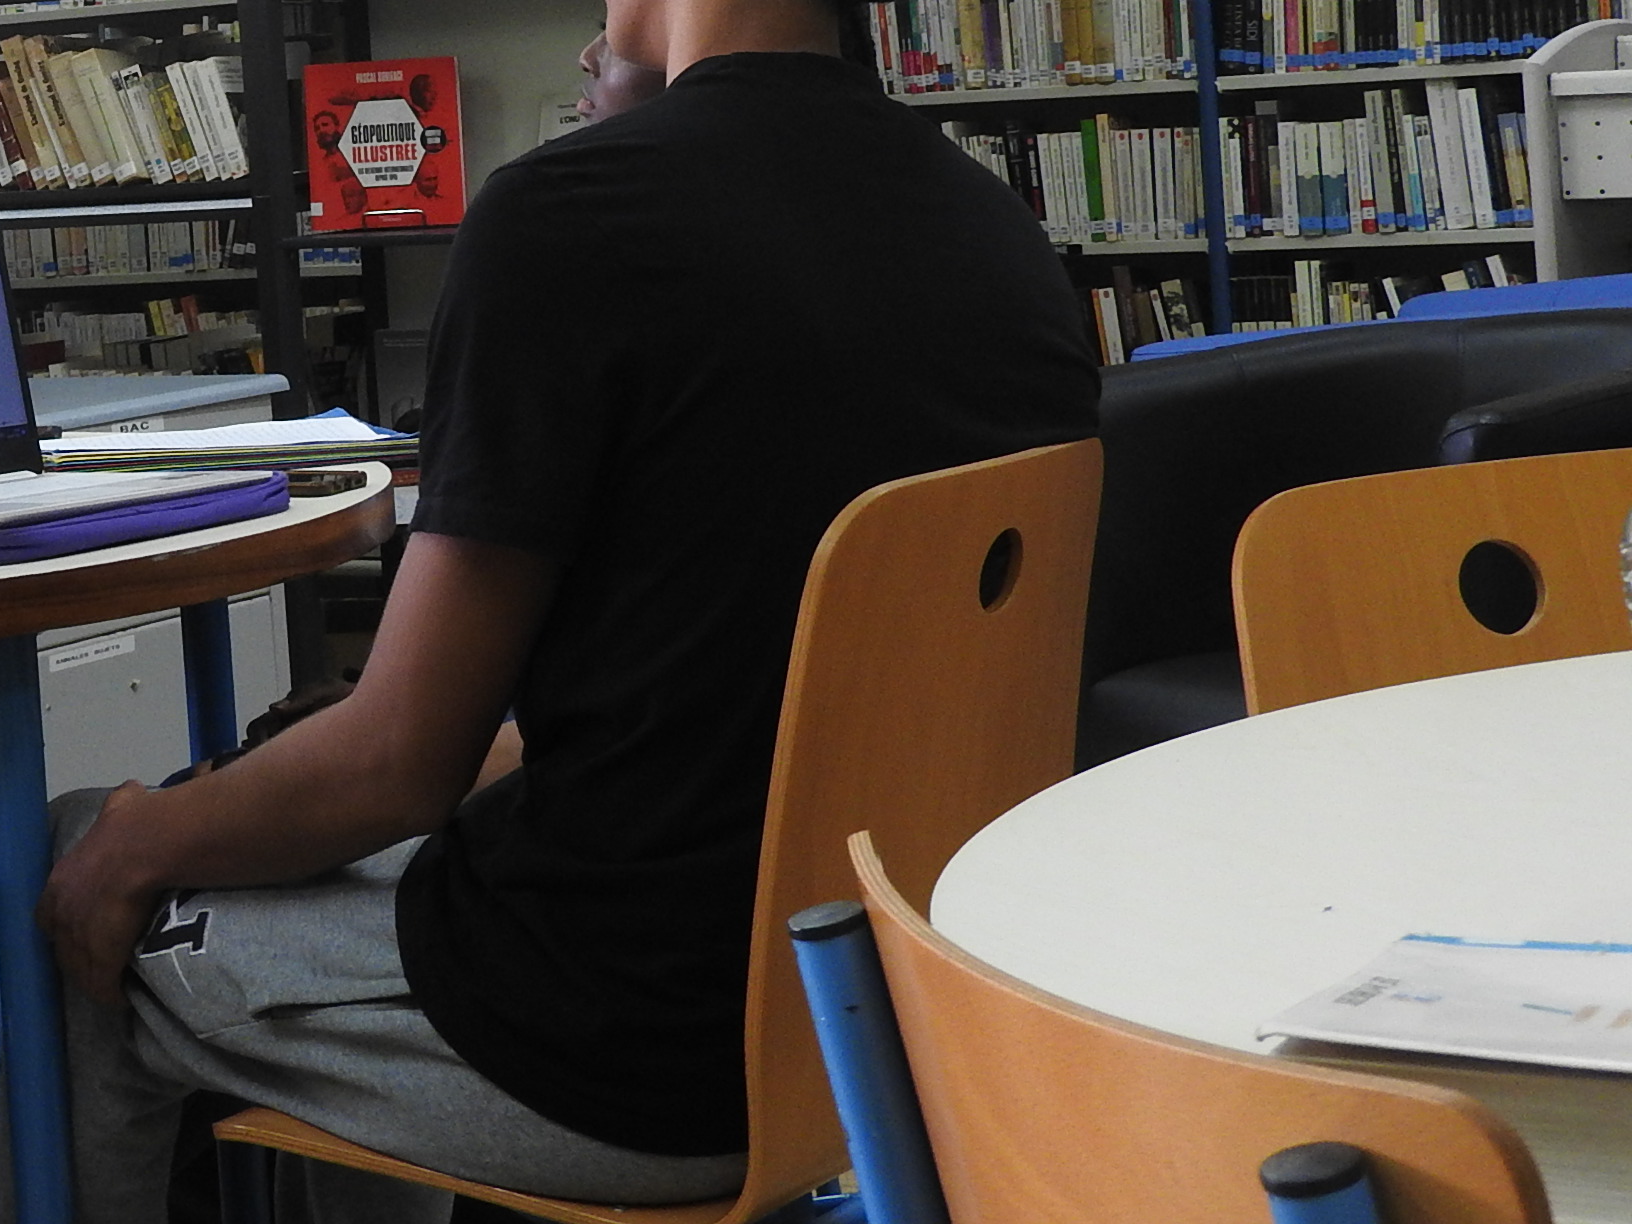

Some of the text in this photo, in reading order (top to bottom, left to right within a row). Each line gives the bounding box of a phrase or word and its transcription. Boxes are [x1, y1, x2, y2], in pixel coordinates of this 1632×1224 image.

[351, 122, 416, 144] GÉOPOLITIQUE
[352, 143, 417, 164] ILLUSTRÉE
[120, 421, 150, 433] BAC
